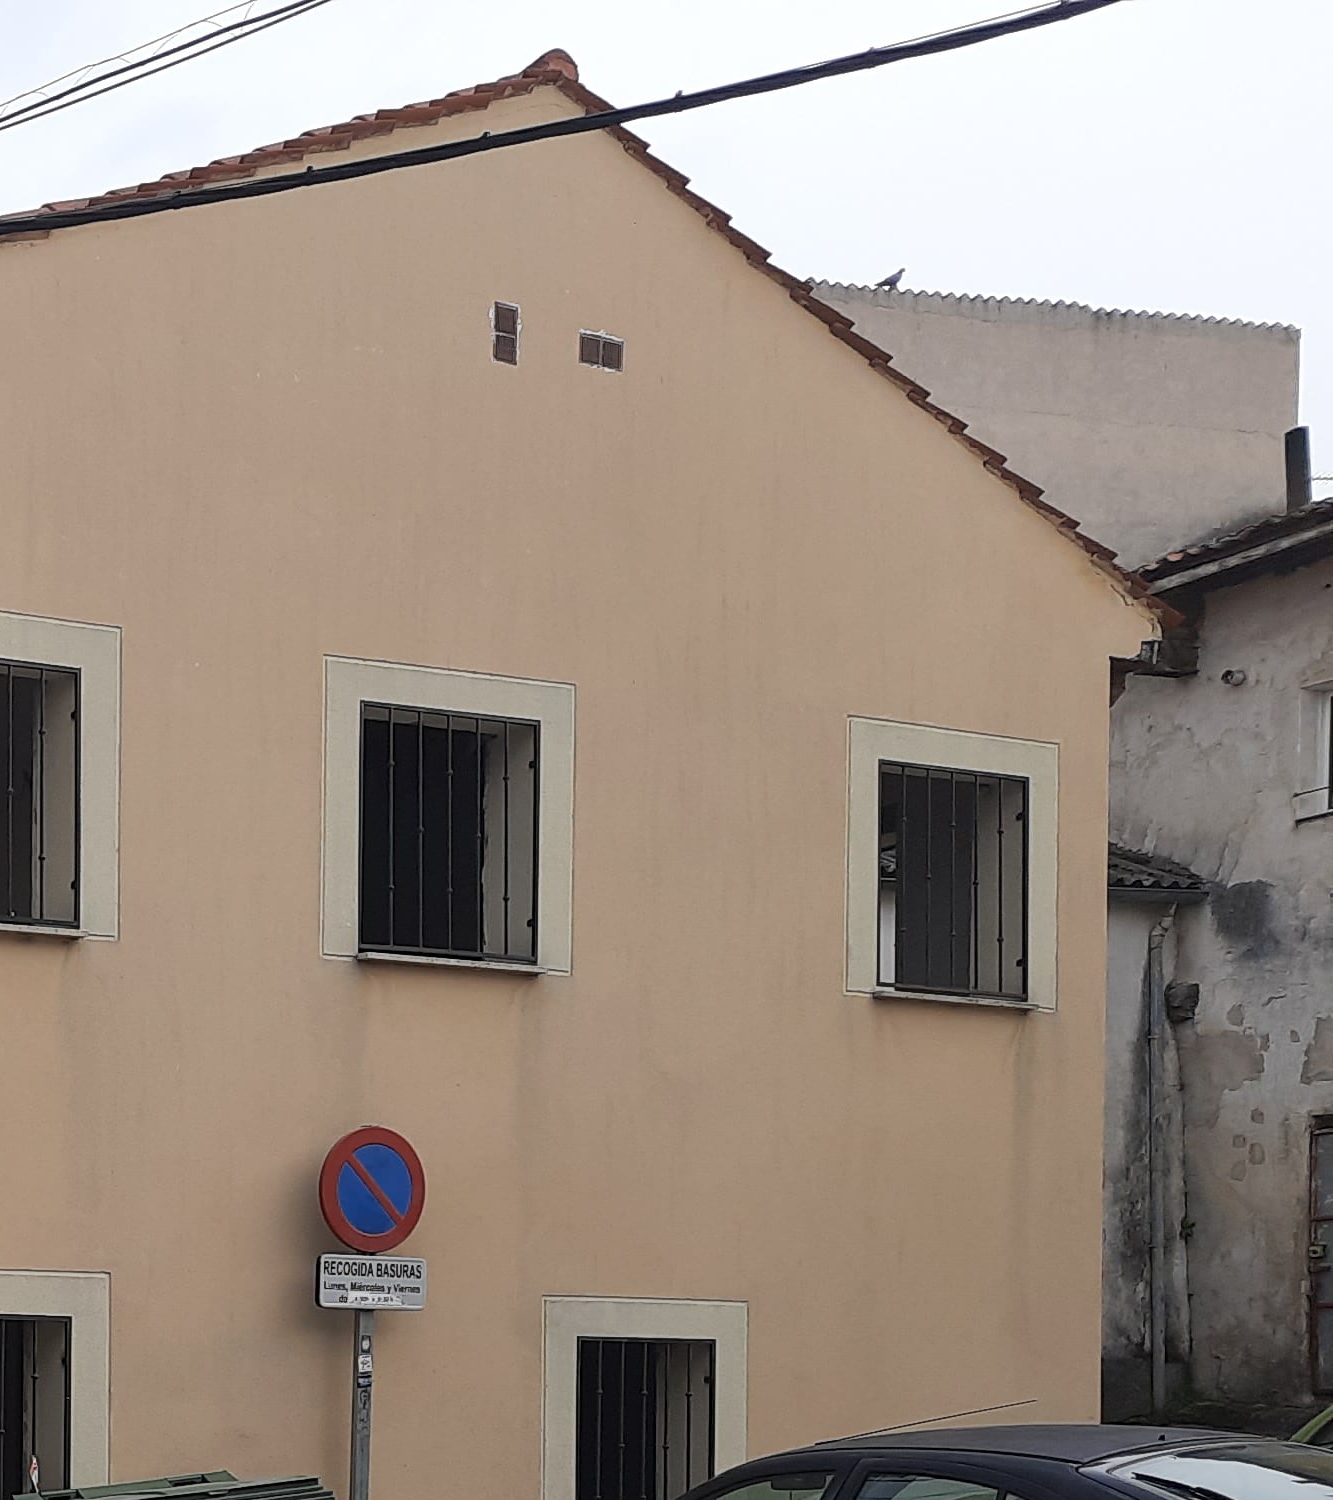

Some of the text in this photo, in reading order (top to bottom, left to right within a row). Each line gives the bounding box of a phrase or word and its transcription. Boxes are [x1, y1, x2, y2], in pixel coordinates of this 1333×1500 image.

[323, 1260, 422, 1279] RECOGIDA BASURAS
[350, 1282, 385, 1293] Miércoles
[386, 1286, 392, 1294] y
[393, 1284, 421, 1294] Viernes
